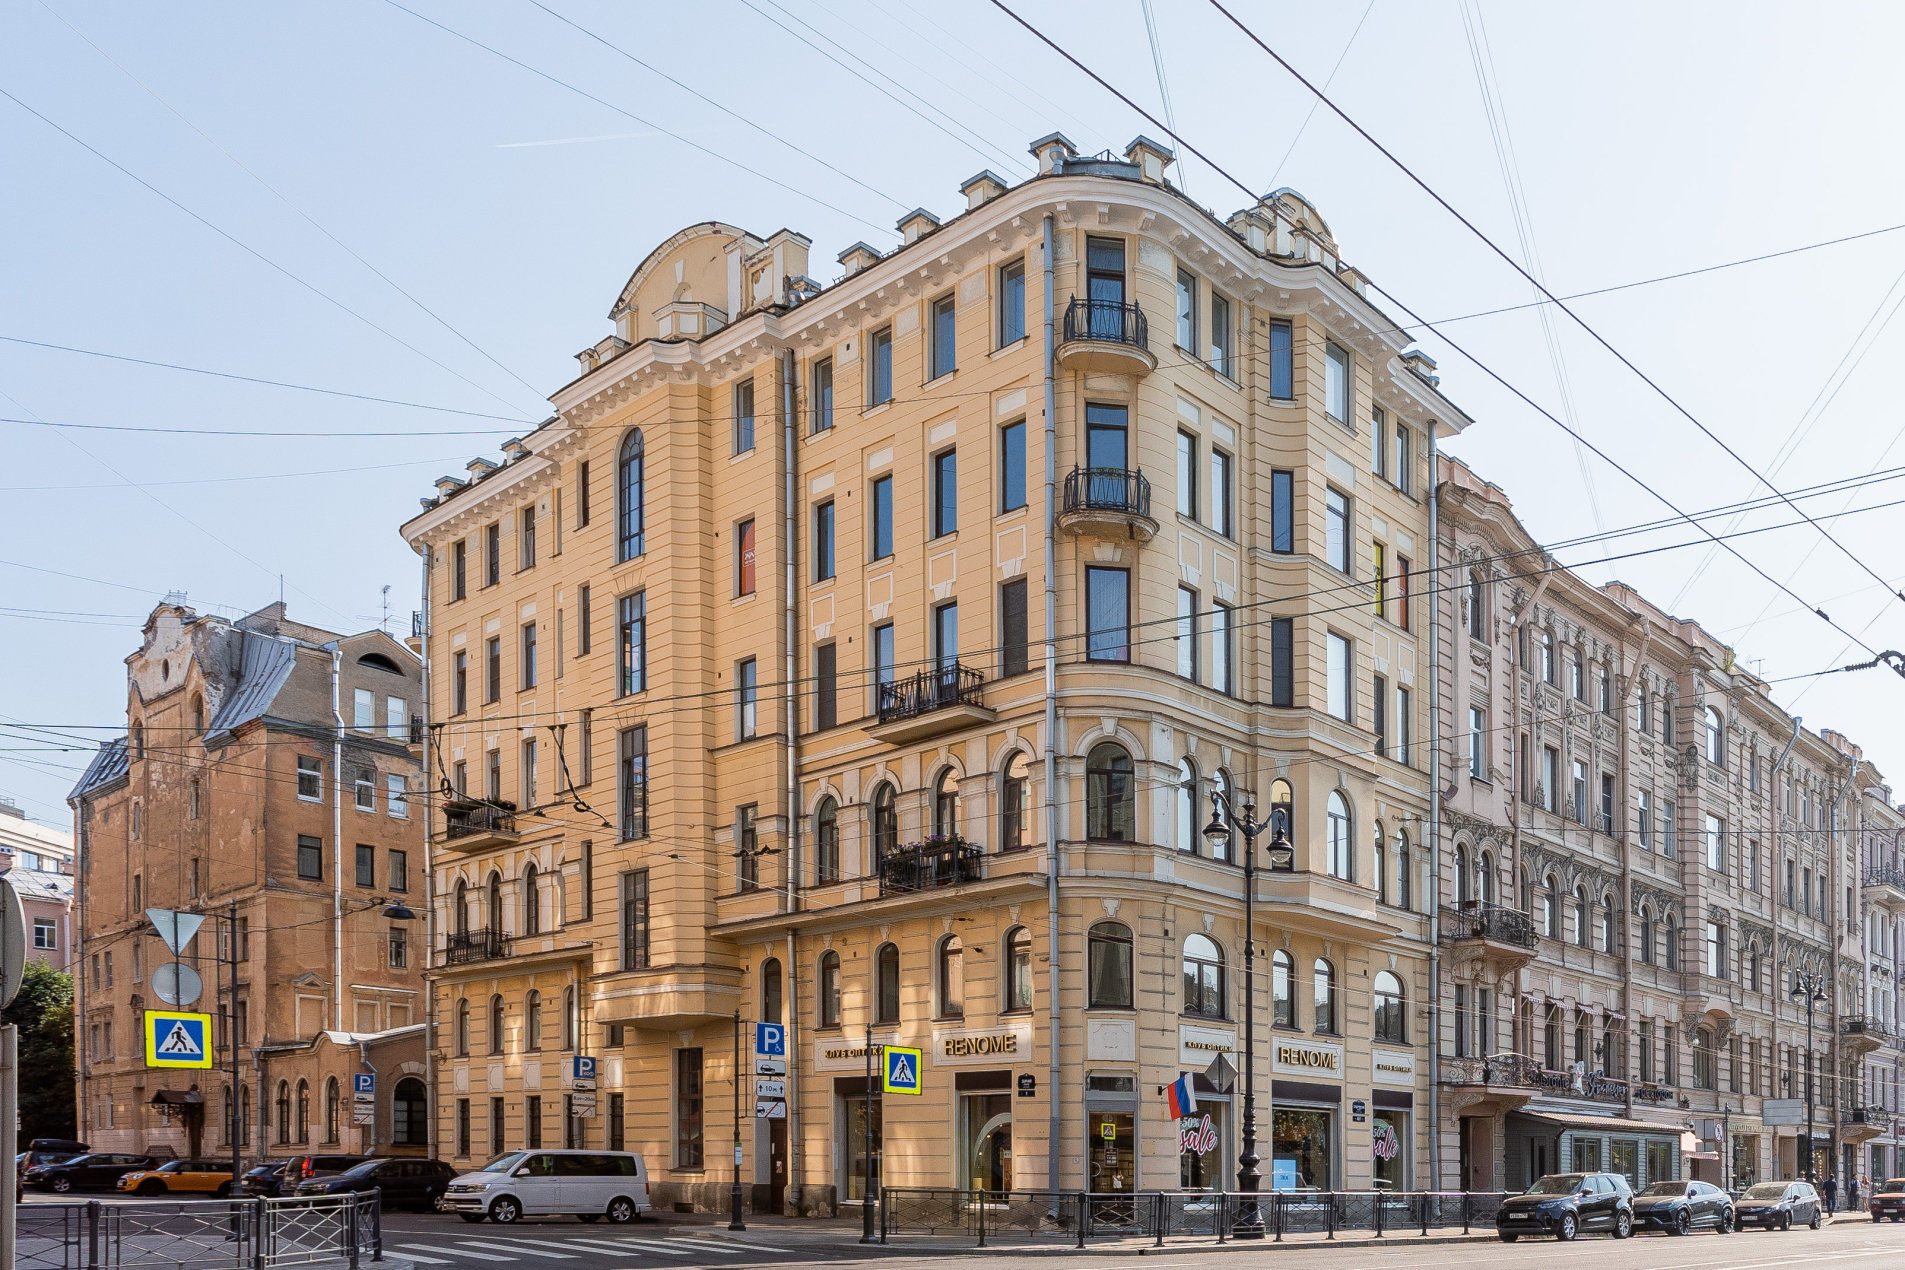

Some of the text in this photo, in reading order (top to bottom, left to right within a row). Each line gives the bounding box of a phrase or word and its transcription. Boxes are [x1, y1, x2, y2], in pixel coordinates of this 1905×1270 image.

[764, 1027, 780, 1052] P
[945, 1035, 1016, 1055] RENOME
[824, 1049, 847, 1058] КЛУБ
[1279, 1047, 1340, 1069] RENOME
[580, 1058, 593, 1076] P
[360, 1076, 371, 1091] P
